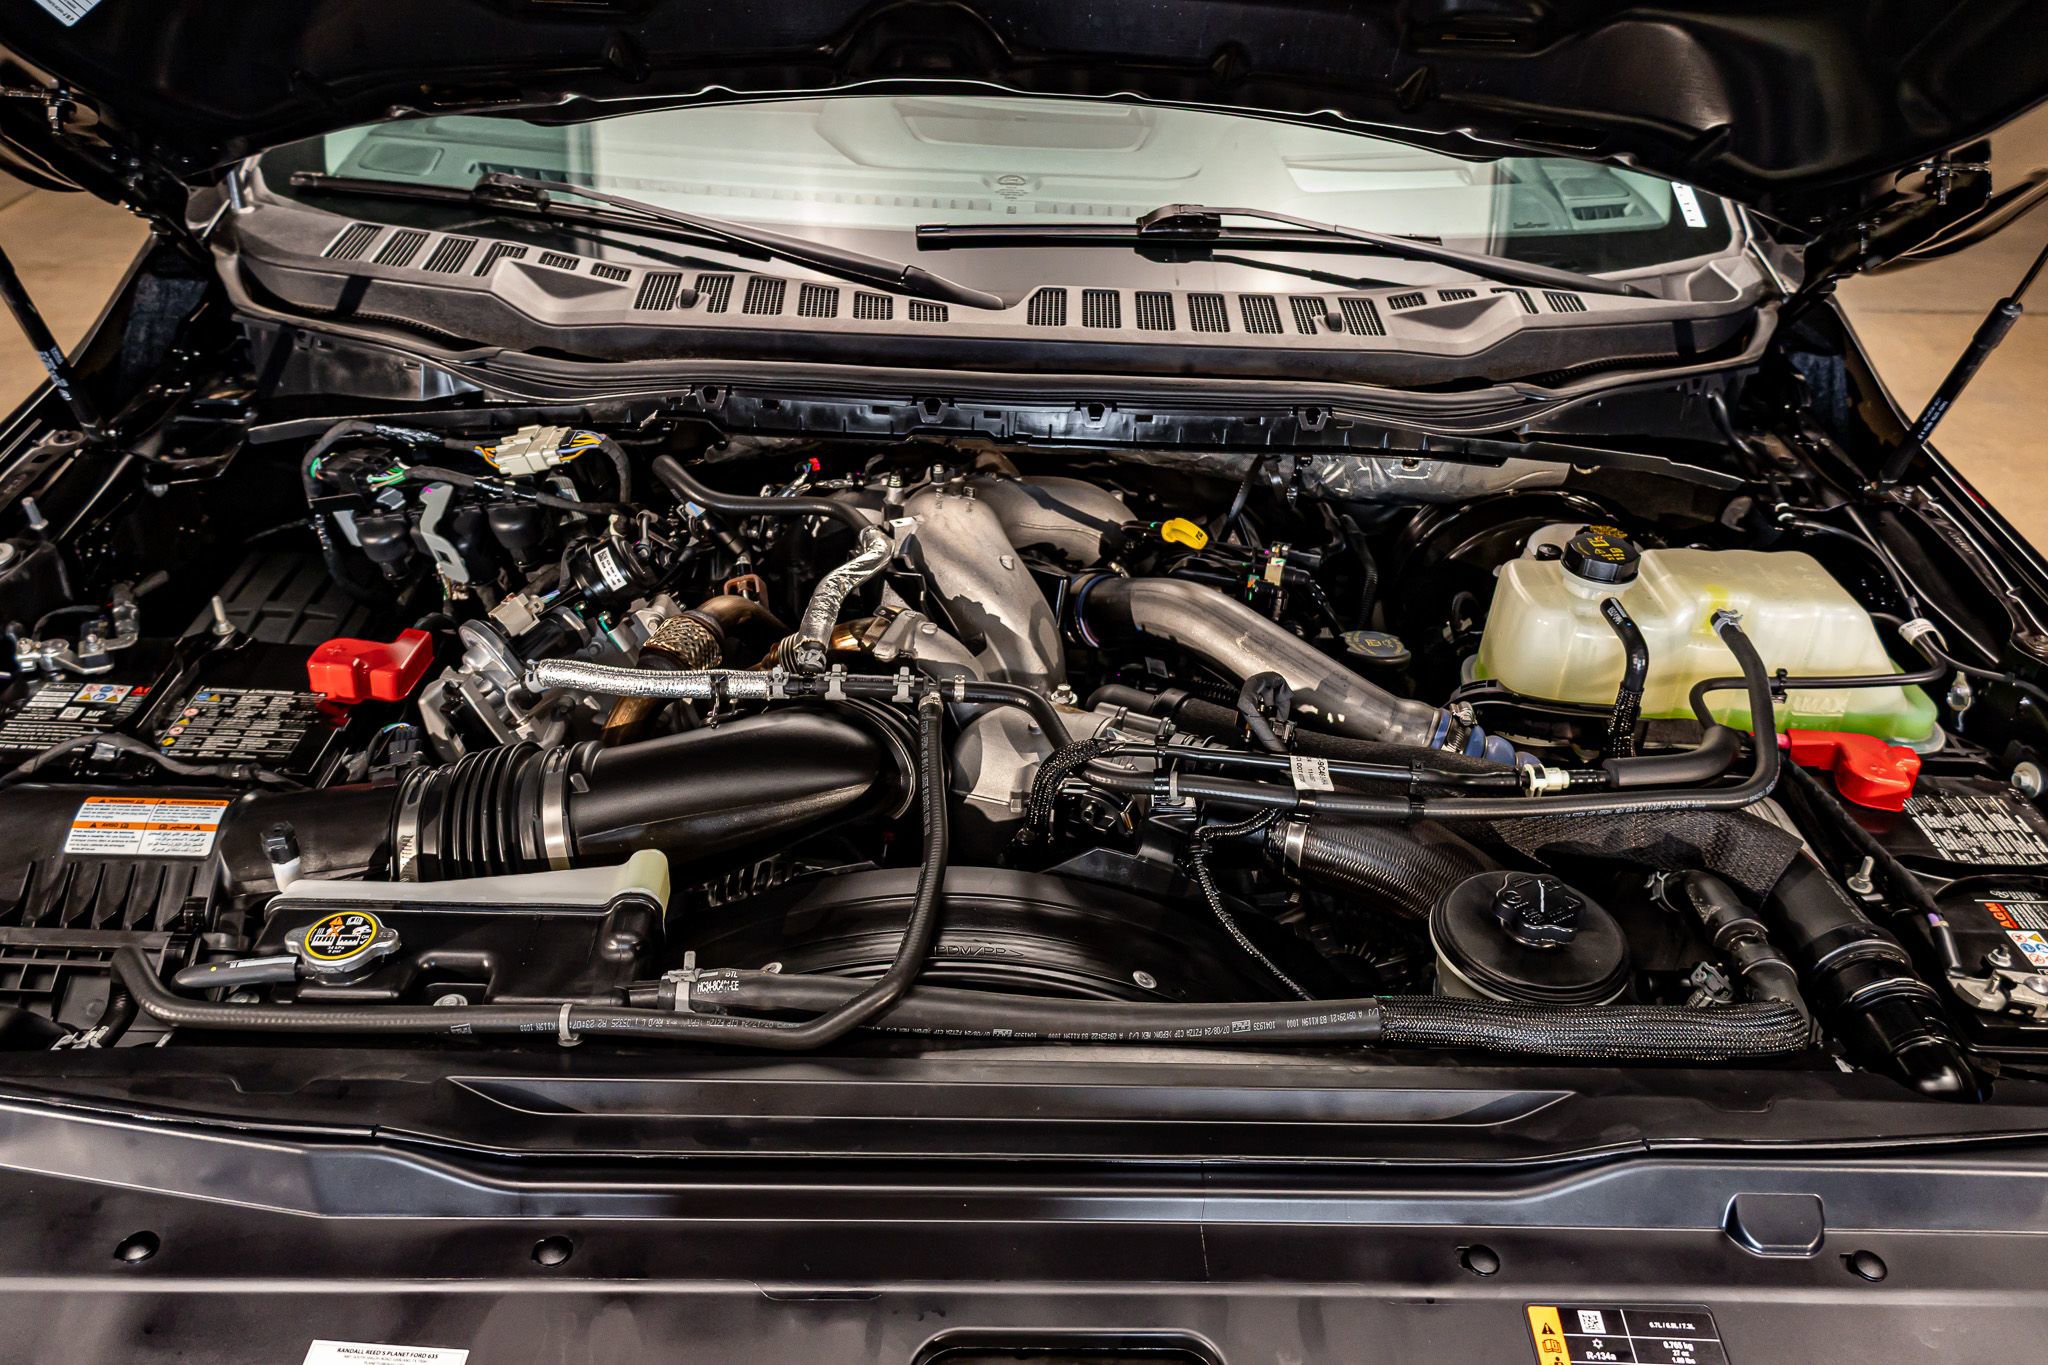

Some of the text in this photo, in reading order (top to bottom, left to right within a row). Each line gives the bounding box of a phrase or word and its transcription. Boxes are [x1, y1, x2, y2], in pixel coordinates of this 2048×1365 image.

[1984, 903, 2014, 929] AGM
[1204, 1025, 1230, 1035] 07/08/24
[1683, 1342, 1694, 1351] kg
[1586, 1351, 1617, 1361] R-134a
